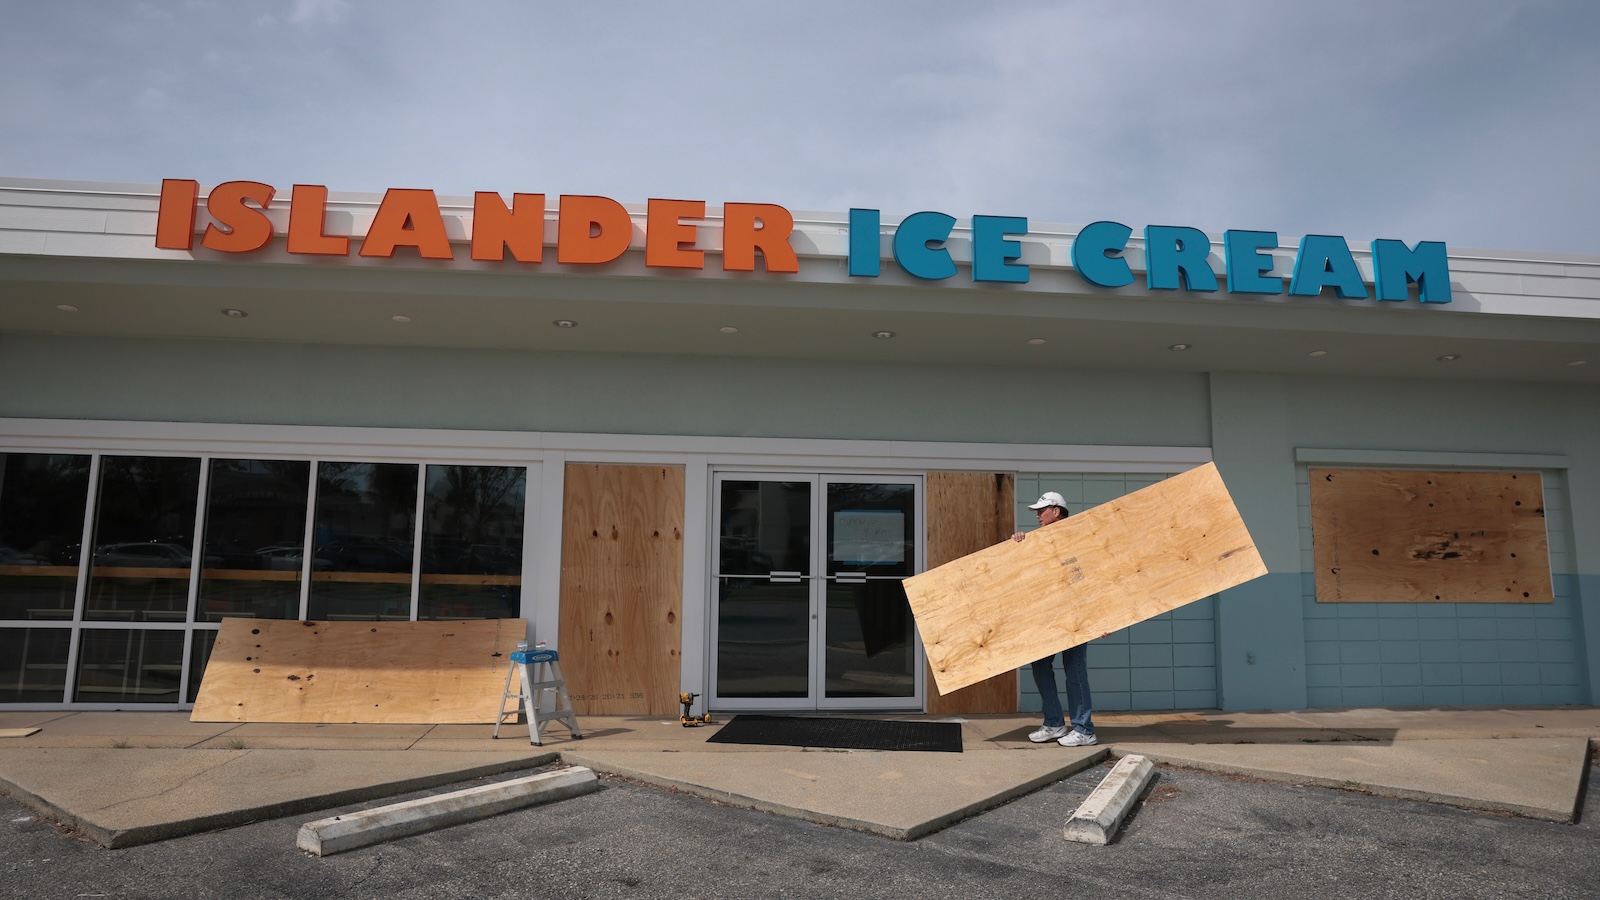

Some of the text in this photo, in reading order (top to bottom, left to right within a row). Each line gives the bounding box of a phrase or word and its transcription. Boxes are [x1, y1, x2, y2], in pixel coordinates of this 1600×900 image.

[155, 178, 1452, 304] ISLANDER ICE CREAM
